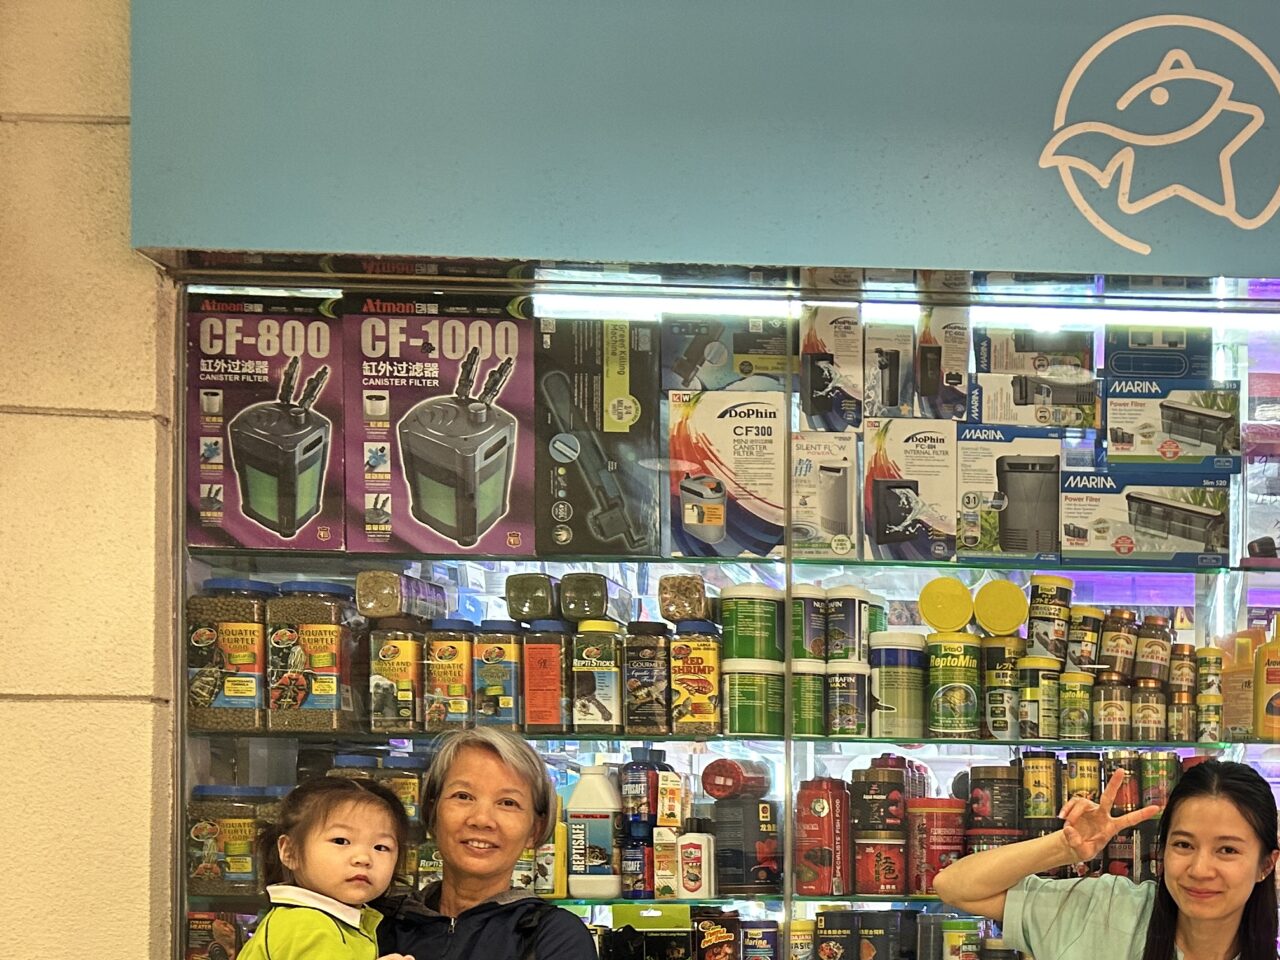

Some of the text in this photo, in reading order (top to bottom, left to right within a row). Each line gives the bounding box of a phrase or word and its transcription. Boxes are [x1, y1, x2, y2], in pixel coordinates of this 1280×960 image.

[201, 300, 244, 313] Atman
[362, 299, 415, 314] Atman
[200, 317, 331, 359] CF-800
[361, 317, 519, 360] CF-1000
[200, 358, 269, 374] 缸外过滤器
[362, 360, 439, 378] 缸外过滤器
[200, 373, 269, 383] CANISTER FILTER
[362, 378, 439, 387] CANISTER FILTER
[1109, 380, 1162, 394] MARINA
[971, 388, 980, 420] MARINA
[728, 409, 777, 419] DoPhin
[733, 426, 773, 437] CF300
[961, 429, 1005, 441] MARINA
[911, 435, 945, 444] DoPhin
[1064, 475, 1117, 489] MARINA
[1064, 495, 1084, 503] Power
[219, 629, 260, 637] AQUATIC
[300, 629, 338, 637] AQUATIC
[222, 637, 256, 645] TURTLE
[302, 637, 337, 645] TURTLE
[682, 656, 705, 667] RED
[930, 654, 978, 668] ReptoMin
[671, 664, 715, 675] SHRIMP
[996, 663, 1015, 671] レプト
[572, 823, 585, 872] REPTISAFE
[744, 938, 768, 946] Marine
